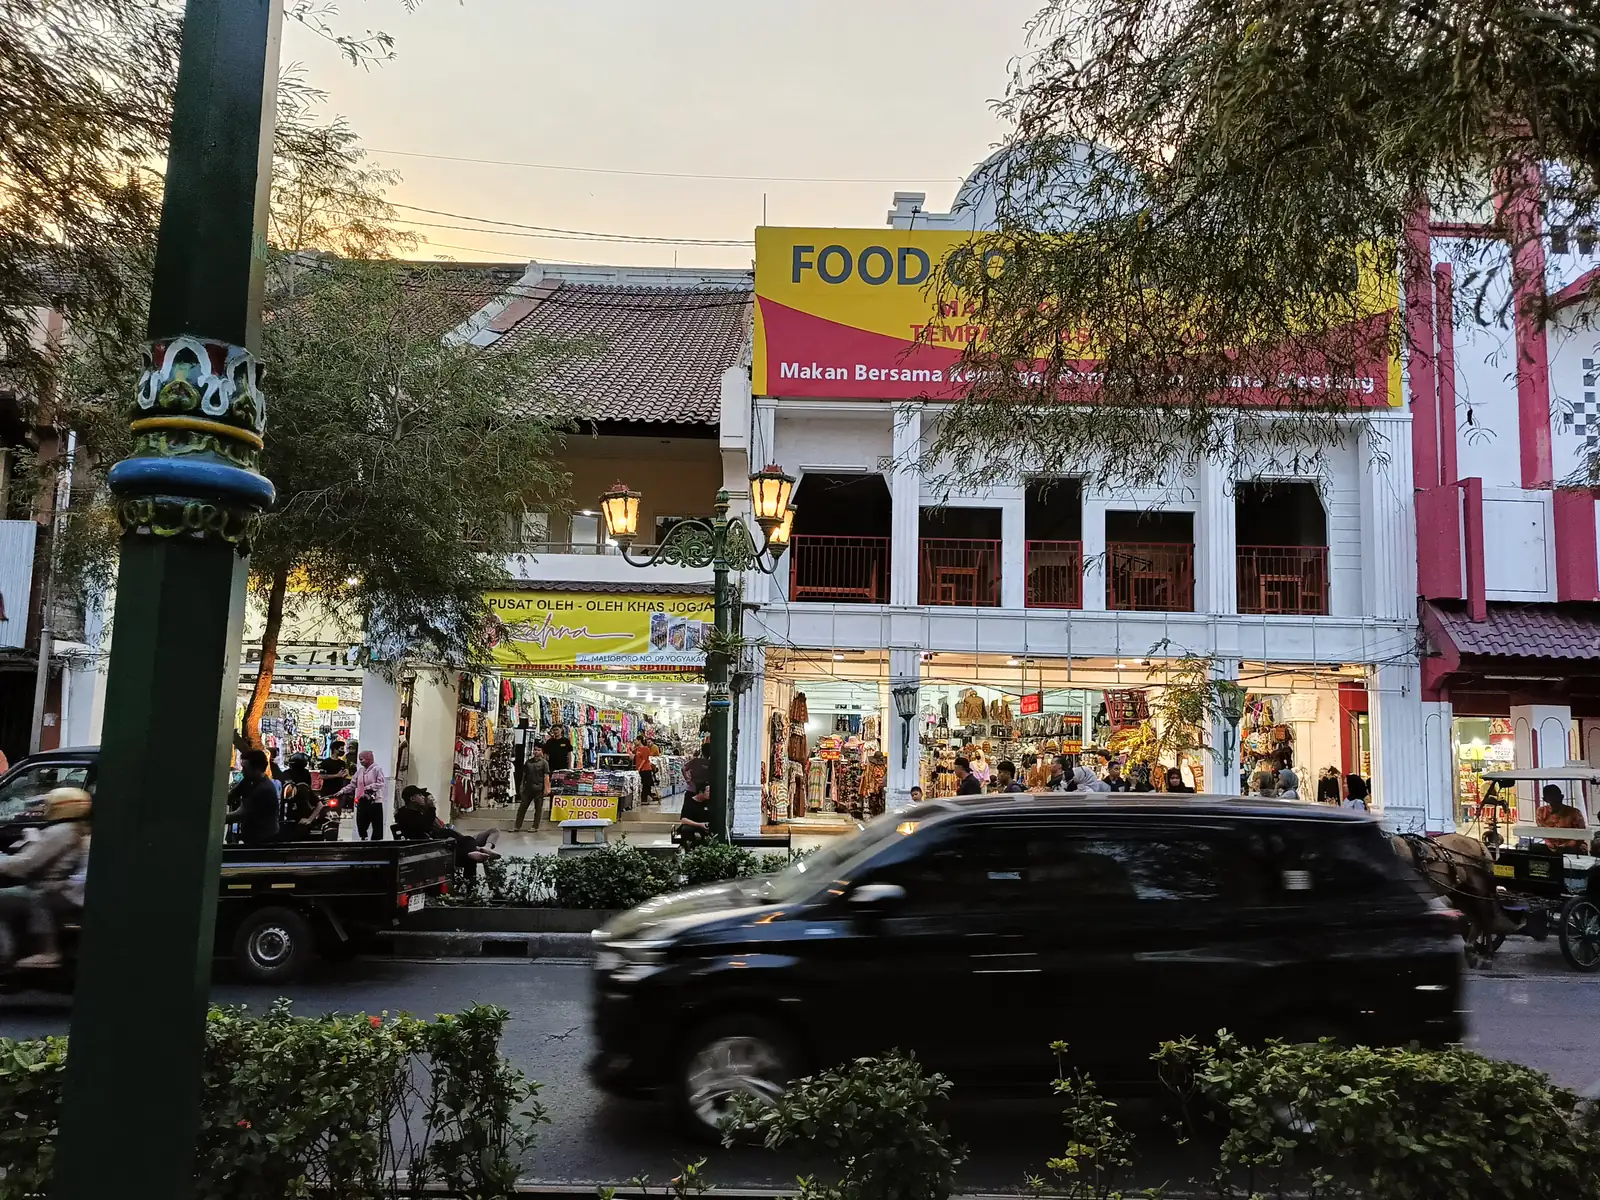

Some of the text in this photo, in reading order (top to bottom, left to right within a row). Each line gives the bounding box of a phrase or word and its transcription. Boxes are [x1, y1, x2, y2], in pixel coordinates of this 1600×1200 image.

[791, 244, 931, 286] FOOD
[780, 362, 848, 380] Makan
[855, 364, 942, 383] Bersama
[489, 598, 533, 610] PUSAT
[536, 600, 574, 611] OLEH
[586, 600, 623, 612] OLEH
[627, 601, 665, 612] KHAS
[668, 602, 714, 613] JOGJA
[591, 655, 639, 663] MALIOBORO
[554, 797, 568, 808] Rp
[568, 810, 599, 820] 7 PCS
